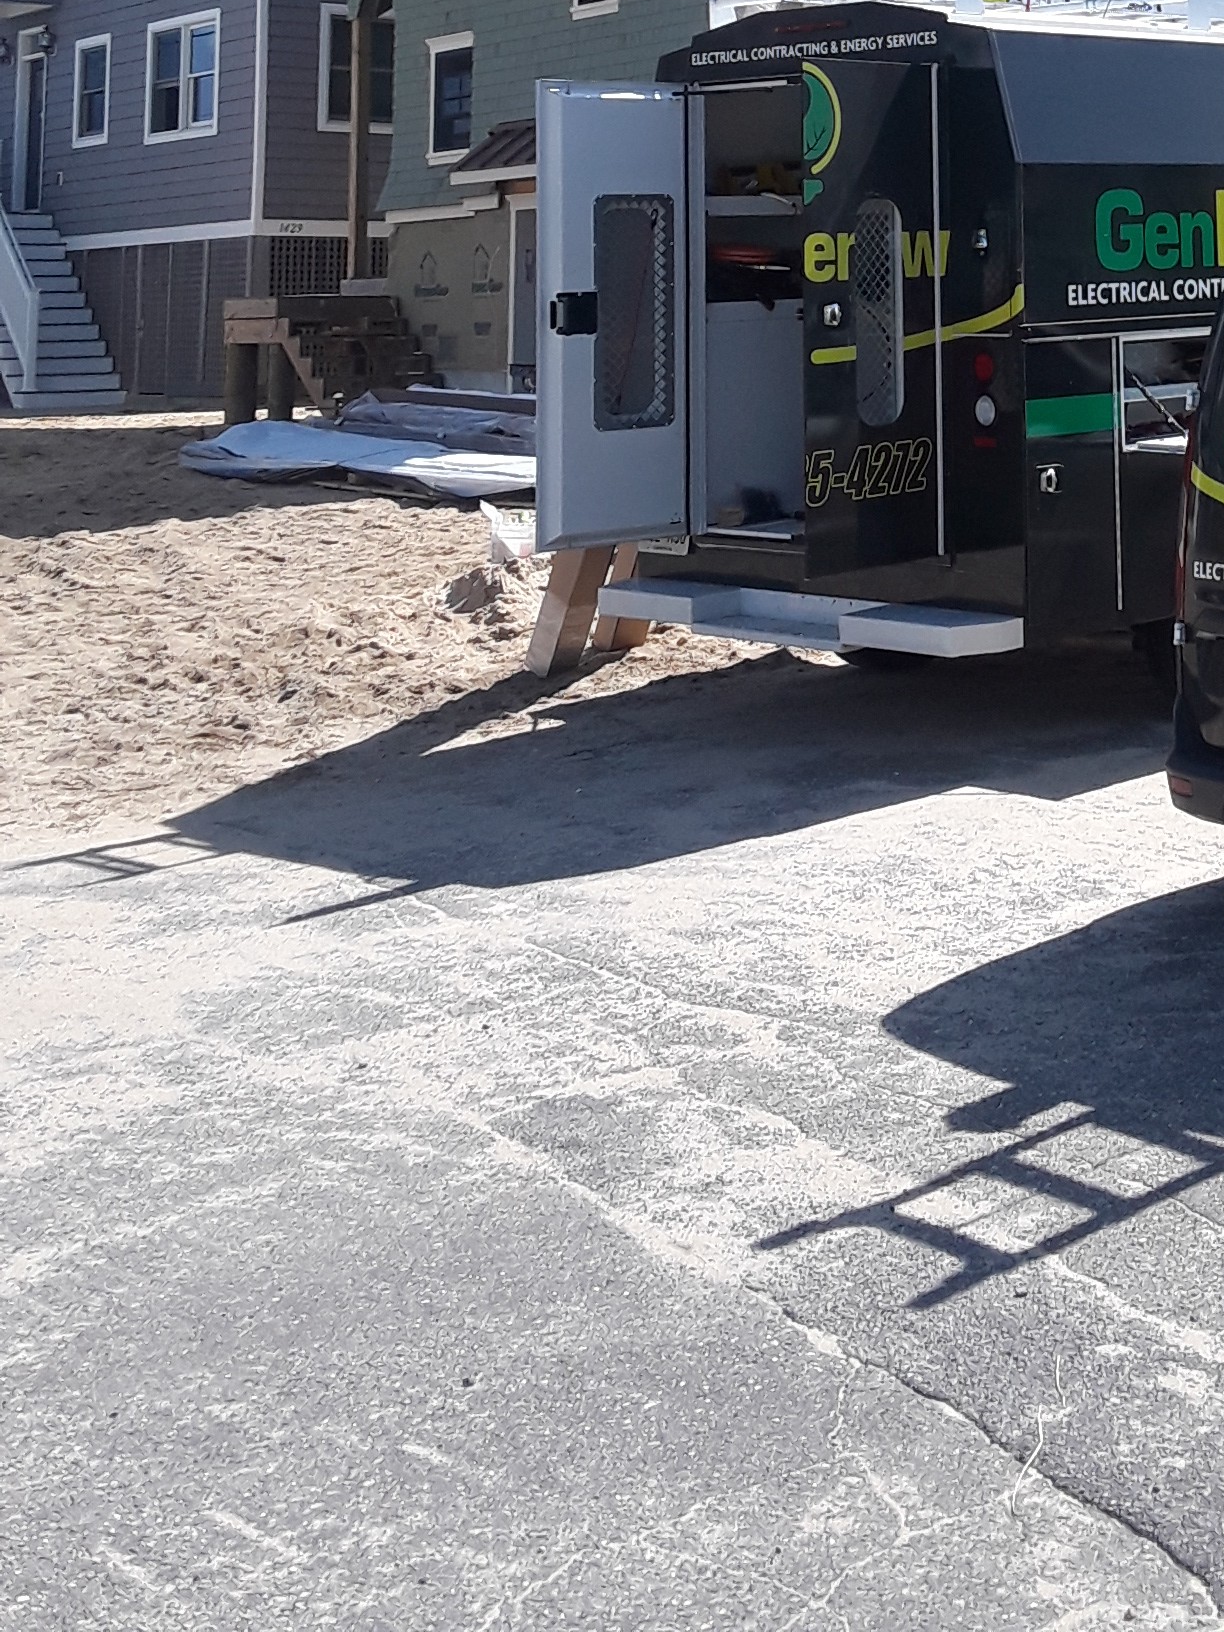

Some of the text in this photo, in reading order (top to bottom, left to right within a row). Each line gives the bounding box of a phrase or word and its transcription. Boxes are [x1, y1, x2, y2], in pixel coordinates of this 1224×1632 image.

[691, 30, 938, 66] ELECTRICAL CONTRACTING & ENERGY SERVICES
[1067, 281, 1170, 306] ELECTRICAL
[805, 437, 933, 508] 5-4272
